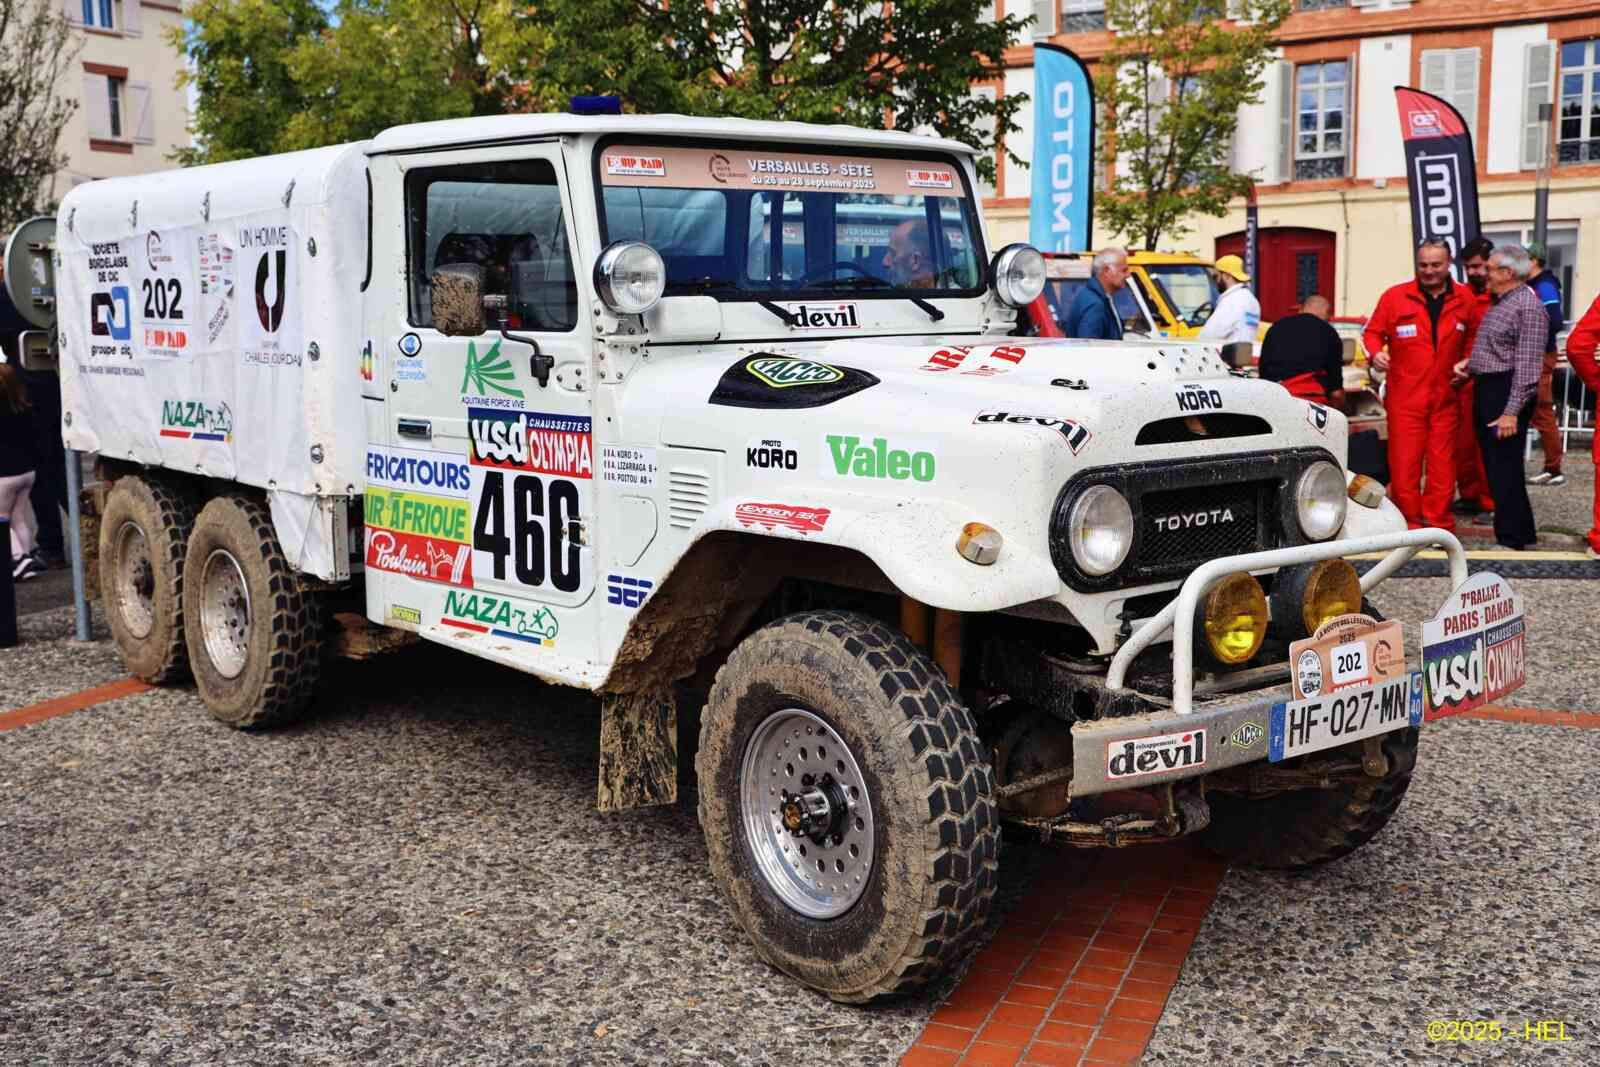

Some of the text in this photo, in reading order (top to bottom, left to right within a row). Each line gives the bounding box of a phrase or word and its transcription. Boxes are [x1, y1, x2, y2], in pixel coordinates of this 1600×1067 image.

[748, 159, 830, 175] VERSAILLES
[854, 180, 876, 190] 2025
[240, 226, 287, 248] UN HOMME
[142, 278, 184, 319] 202
[791, 304, 858, 327] devil
[91, 345, 117, 357] groupe
[757, 360, 833, 382] YACCO
[461, 397, 526, 409] AQUITAINE FORCE VIVE
[1175, 390, 1223, 411] KORO
[162, 400, 206, 428] NAZA
[471, 413, 591, 463] vsd CHAUSSETTES
[977, 412, 1091, 450] devil
[528, 431, 592, 475] OLYMPIA
[617, 450, 632, 459] KORO
[761, 439, 782, 447] PROTO
[747, 447, 798, 470] KORO
[826, 435, 936, 482] Valeo
[367, 452, 471, 490] FRICATOURS
[617, 473, 638, 483] POITOU
[390, 492, 467, 541] AFRIQUE
[1155, 508, 1235, 531] TOYOTA
[473, 470, 582, 593] 460
[370, 531, 428, 575] Poulain
[1471, 583, 1500, 606] RALLYE
[443, 590, 512, 627] NAZA
[1337, 652, 1362, 674] 202
[1428, 637, 1483, 707] vsd
[1288, 680, 1408, 749] HF-027-MN
[1233, 726, 1264, 745] YACCO
[1109, 731, 1204, 776] devil
